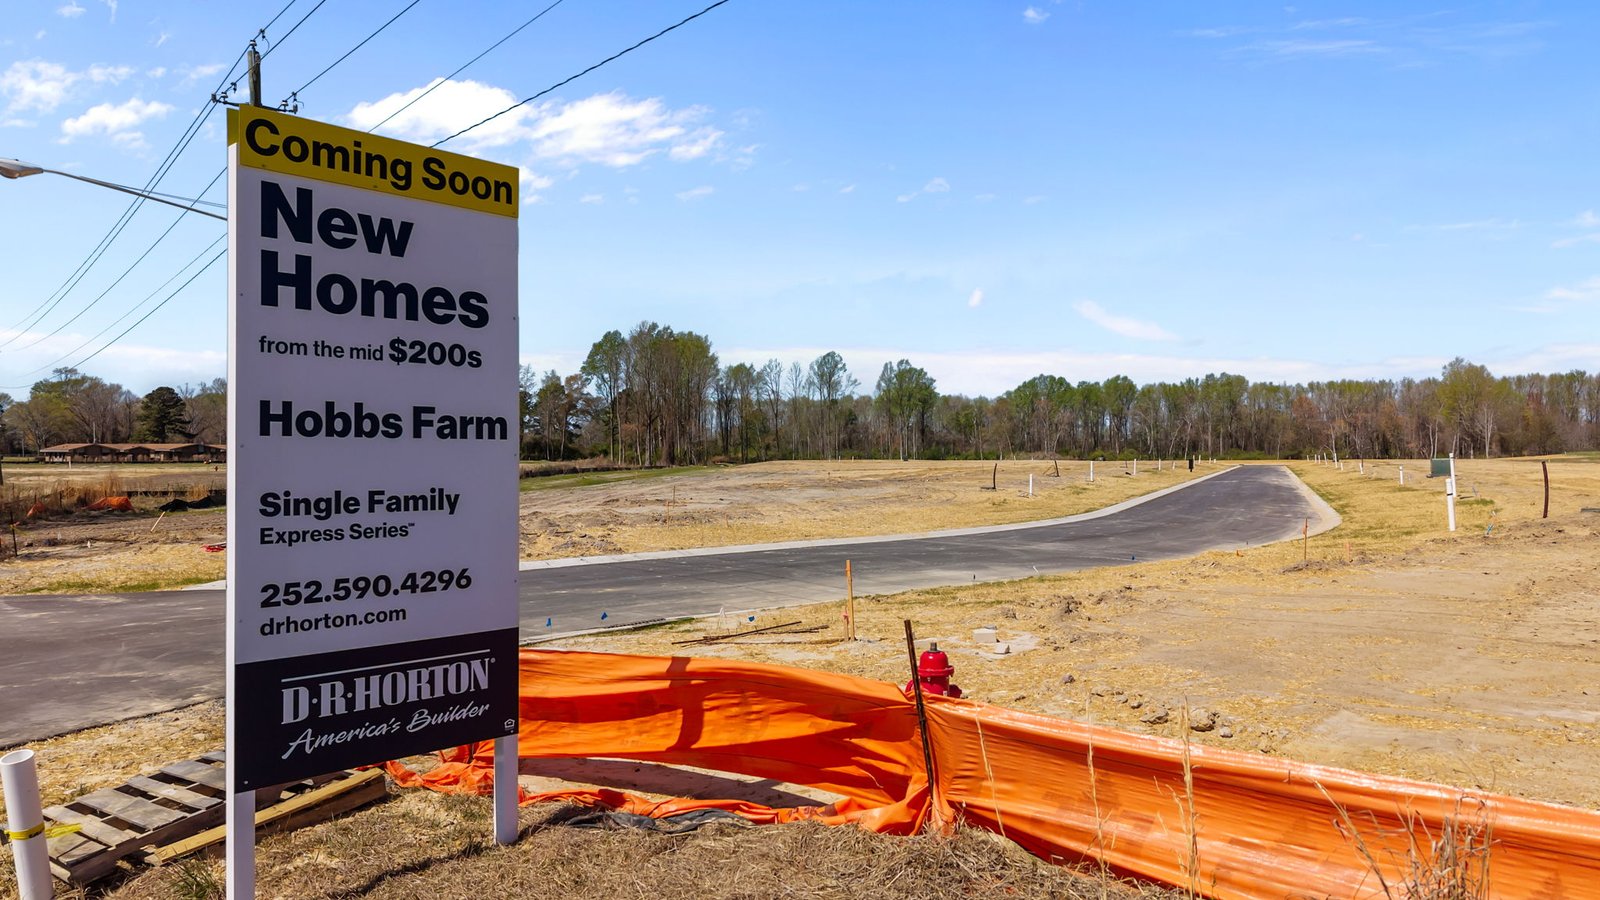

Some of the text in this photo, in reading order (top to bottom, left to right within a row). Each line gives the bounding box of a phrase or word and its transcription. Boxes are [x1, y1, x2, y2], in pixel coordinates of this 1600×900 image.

[245, 118, 513, 205] Coming Soon
[260, 180, 414, 258] New
[260, 249, 490, 329] Homes
[259, 336, 483, 368] from the mid $200s
[259, 400, 508, 440] Hobbs Farm
[258, 487, 460, 521] Single Family
[259, 525, 345, 547] Express
[259, 568, 472, 609] 252.590.4296
[259, 607, 407, 637] drhorton.com
[281, 701, 490, 760] America's Builder
